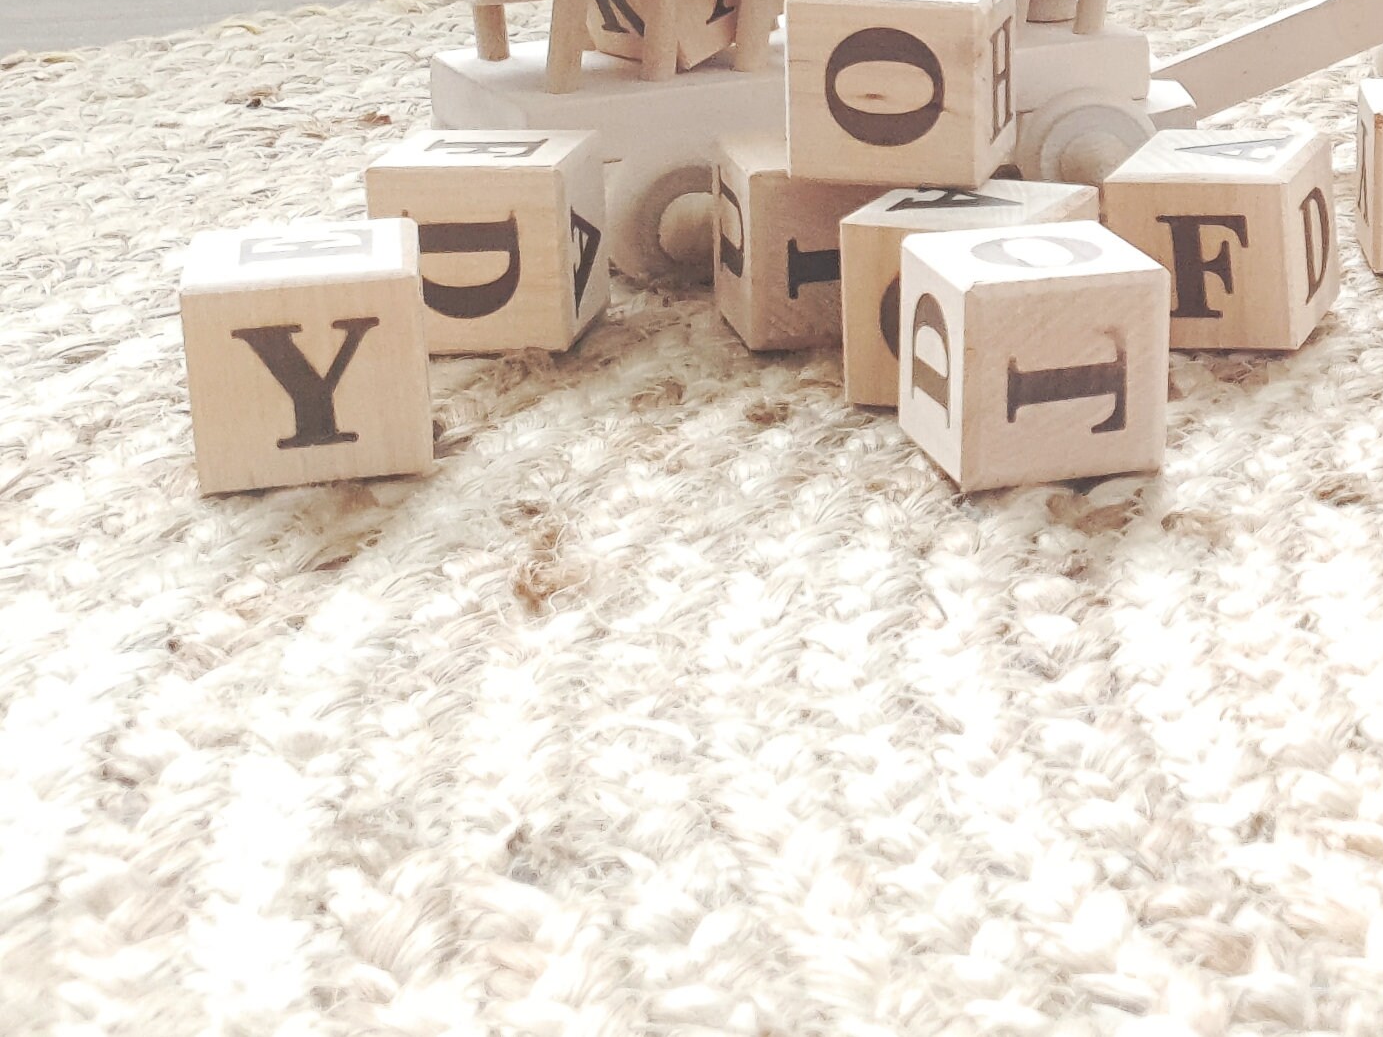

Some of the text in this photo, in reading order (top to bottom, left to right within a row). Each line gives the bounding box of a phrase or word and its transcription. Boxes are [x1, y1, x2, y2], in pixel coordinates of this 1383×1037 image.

[825, 27, 944, 146] O
[1174, 135, 1295, 163] A
[238, 229, 374, 266] E
[402, 209, 520, 319] D
[1155, 215, 1248, 318] F
[1300, 187, 1330, 305] D
[231, 316, 380, 450] Y
[912, 293, 950, 429] D
[1007, 325, 1127, 434] T
